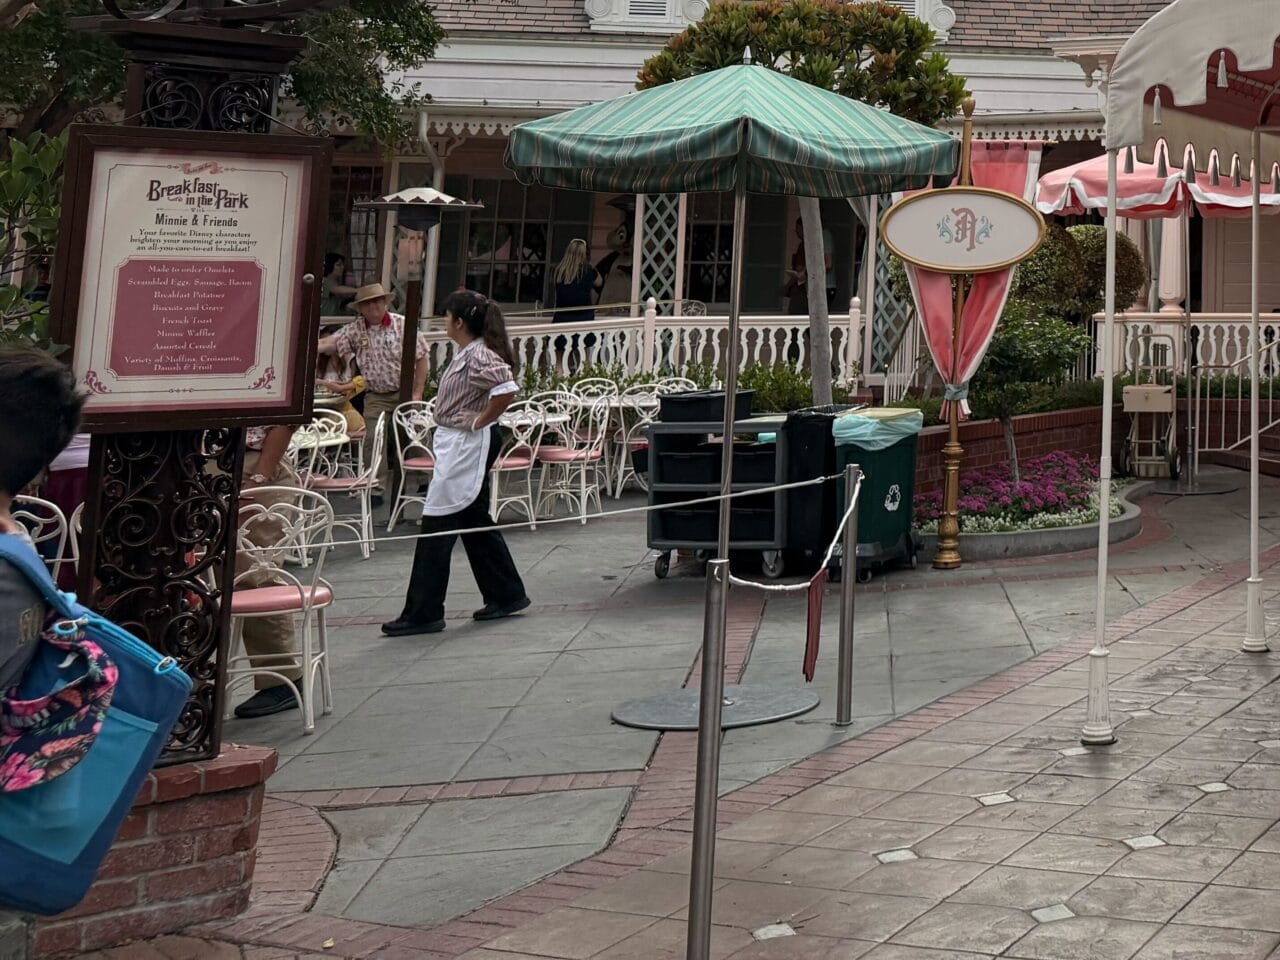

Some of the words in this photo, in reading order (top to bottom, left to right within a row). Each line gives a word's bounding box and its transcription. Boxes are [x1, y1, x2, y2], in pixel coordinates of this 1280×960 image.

[146, 177, 220, 201] Breakfast
[186, 194, 195, 205] in
[197, 194, 213, 208] the
[214, 189, 249, 209] Park
[155, 213, 188, 225] Minnie
[191, 214, 199, 226] &
[202, 215, 238, 227] Friends
[139, 228, 157, 236] Your
[189, 229, 213, 239] Disney
[215, 230, 251, 238] characters
